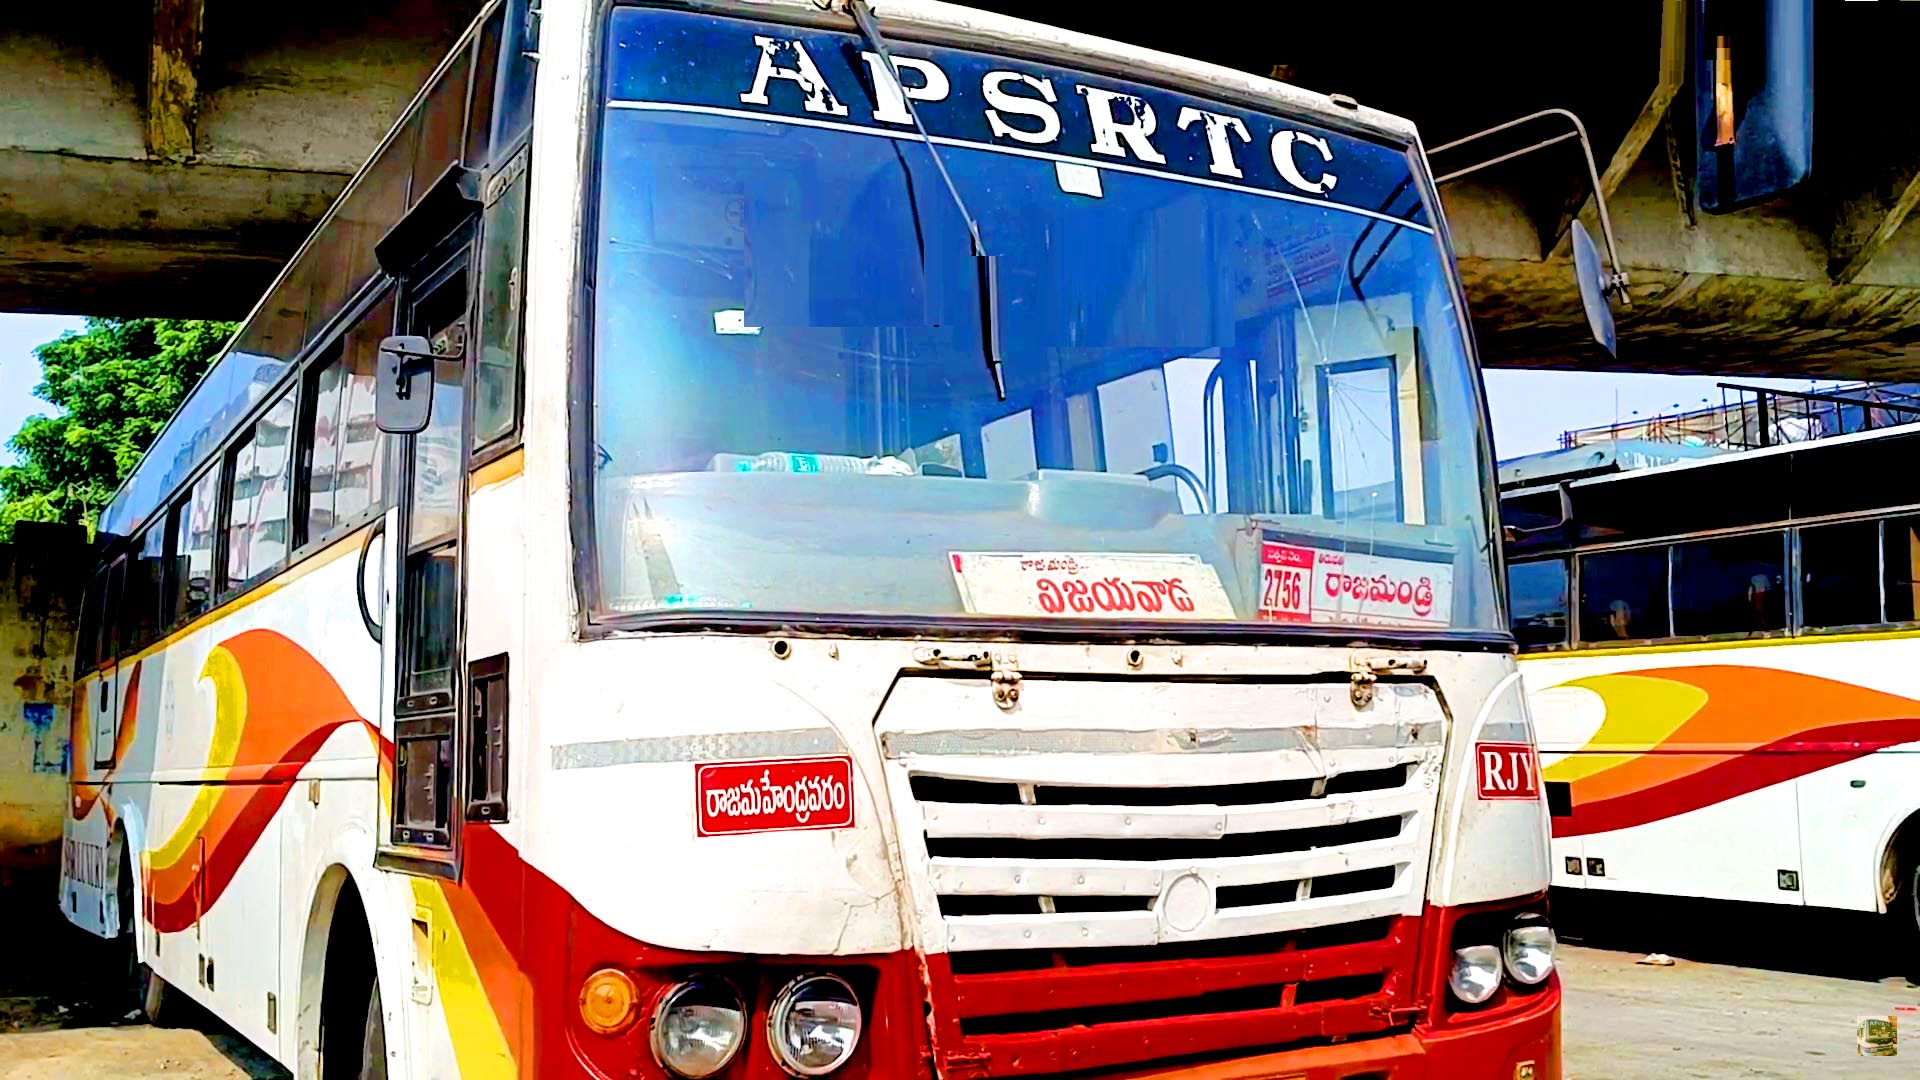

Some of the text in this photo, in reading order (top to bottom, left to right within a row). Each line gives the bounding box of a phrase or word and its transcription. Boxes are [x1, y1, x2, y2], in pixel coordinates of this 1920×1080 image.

[740, 34, 1337, 196] APSRTC
[1036, 577, 1195, 613] విజయవాడ
[1264, 568, 1301, 610] 2756
[1325, 573, 1433, 617] రాజమండ్రి
[1481, 751, 1535, 792] RJY
[705, 769, 846, 823] రాజమహేంద్రవరం
